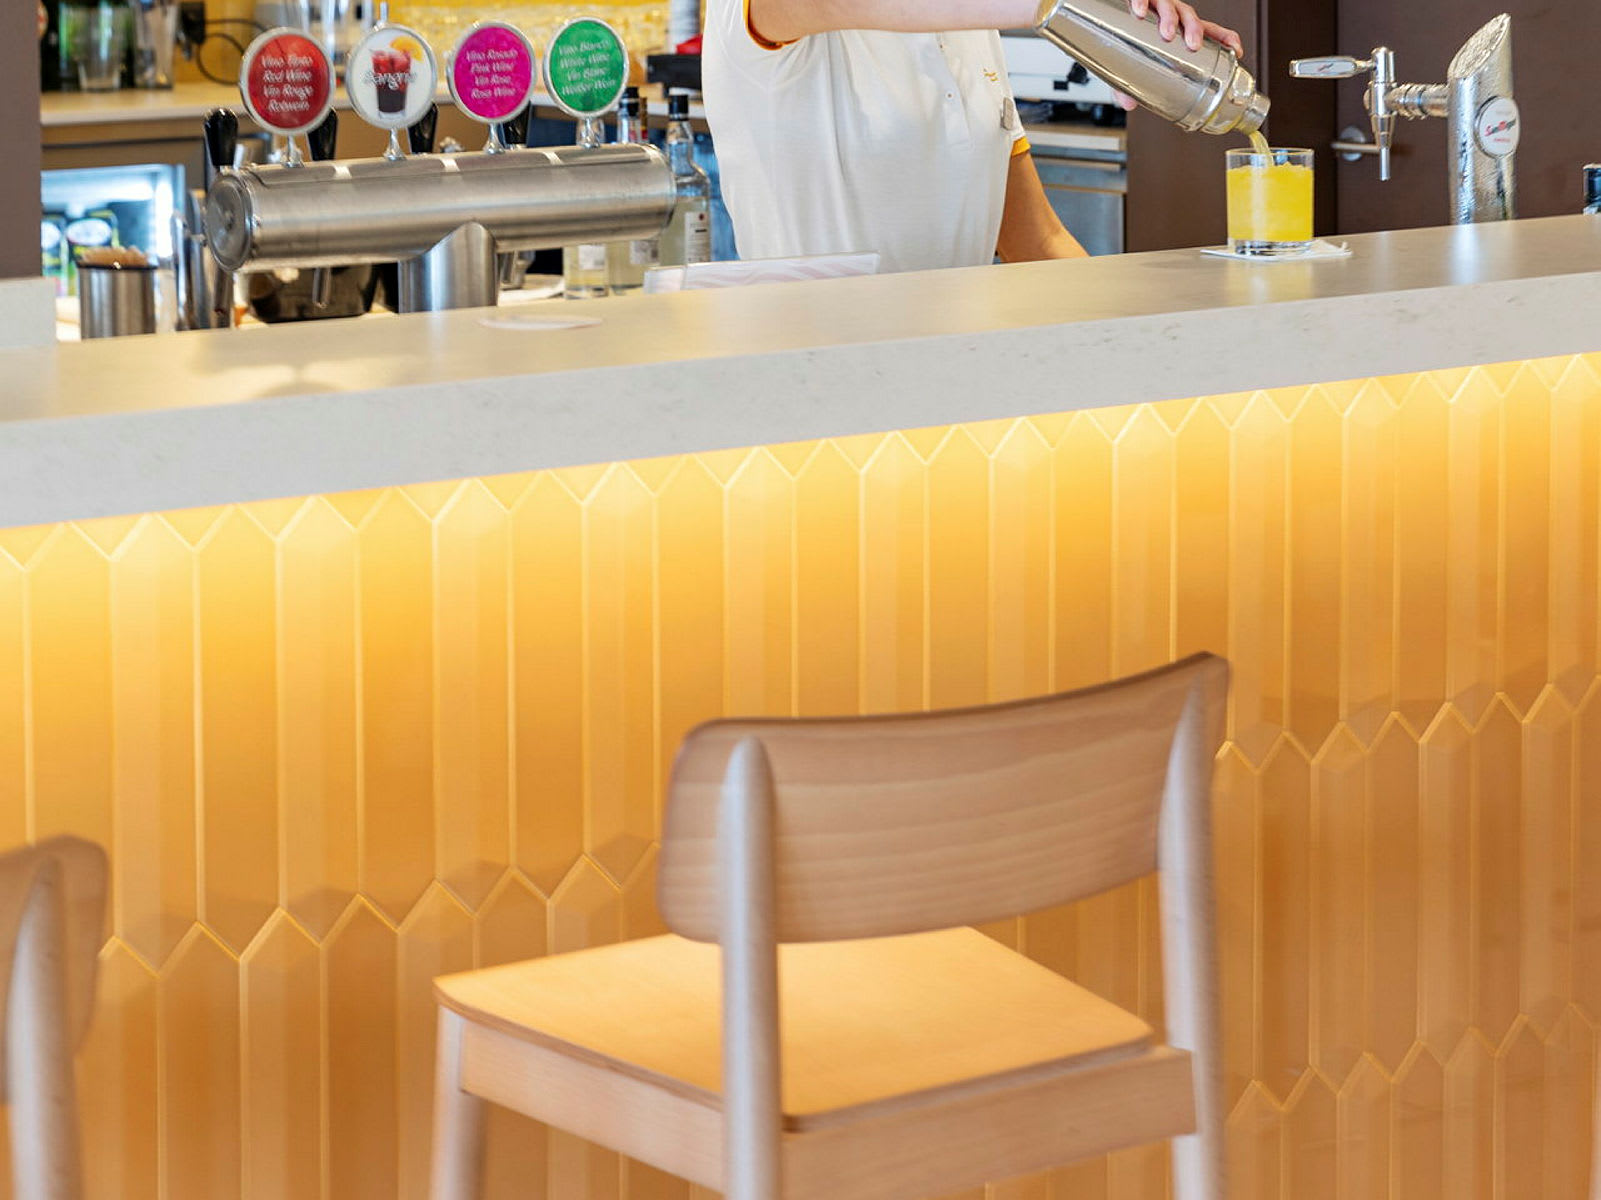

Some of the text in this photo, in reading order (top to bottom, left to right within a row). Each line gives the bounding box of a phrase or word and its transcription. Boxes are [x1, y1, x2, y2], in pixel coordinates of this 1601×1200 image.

[262, 55, 285, 68] Vino
[264, 69, 312, 82] Red Wine
[264, 83, 314, 100] Vin Rouge
